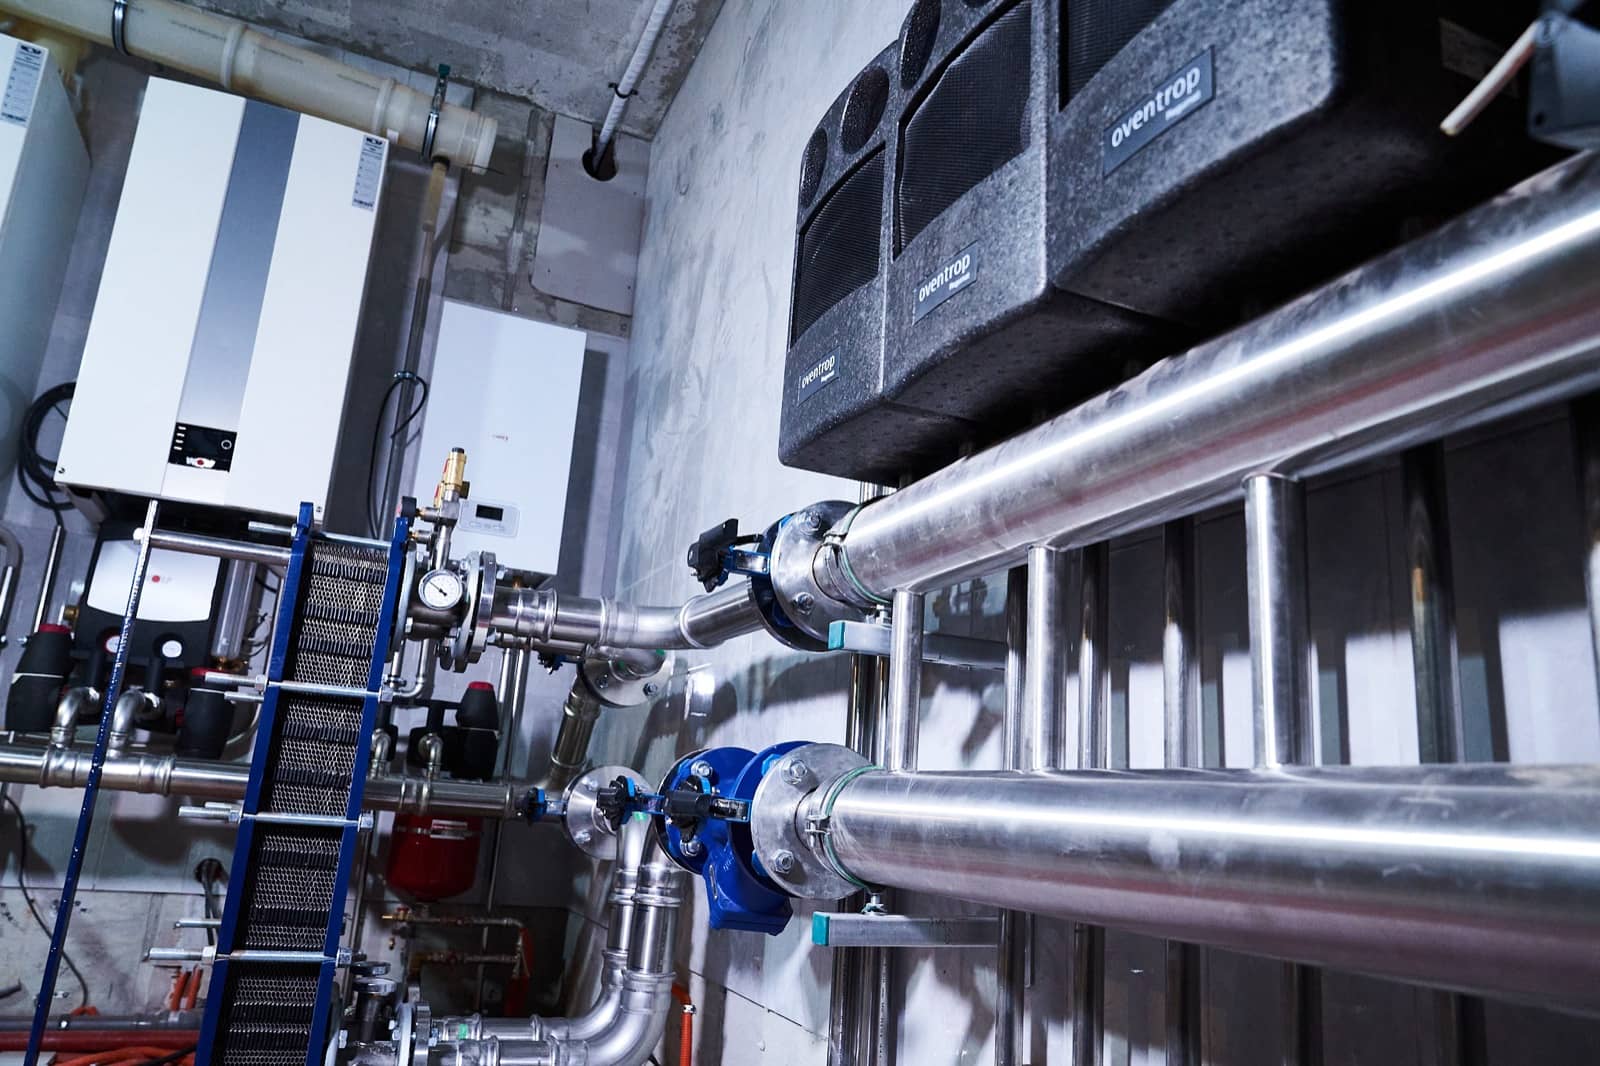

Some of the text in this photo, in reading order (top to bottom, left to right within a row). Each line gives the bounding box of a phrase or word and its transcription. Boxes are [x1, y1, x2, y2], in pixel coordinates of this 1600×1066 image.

[1111, 67, 1200, 148] oventrop
[919, 254, 970, 302] oventrop
[801, 355, 835, 389] oventrop
